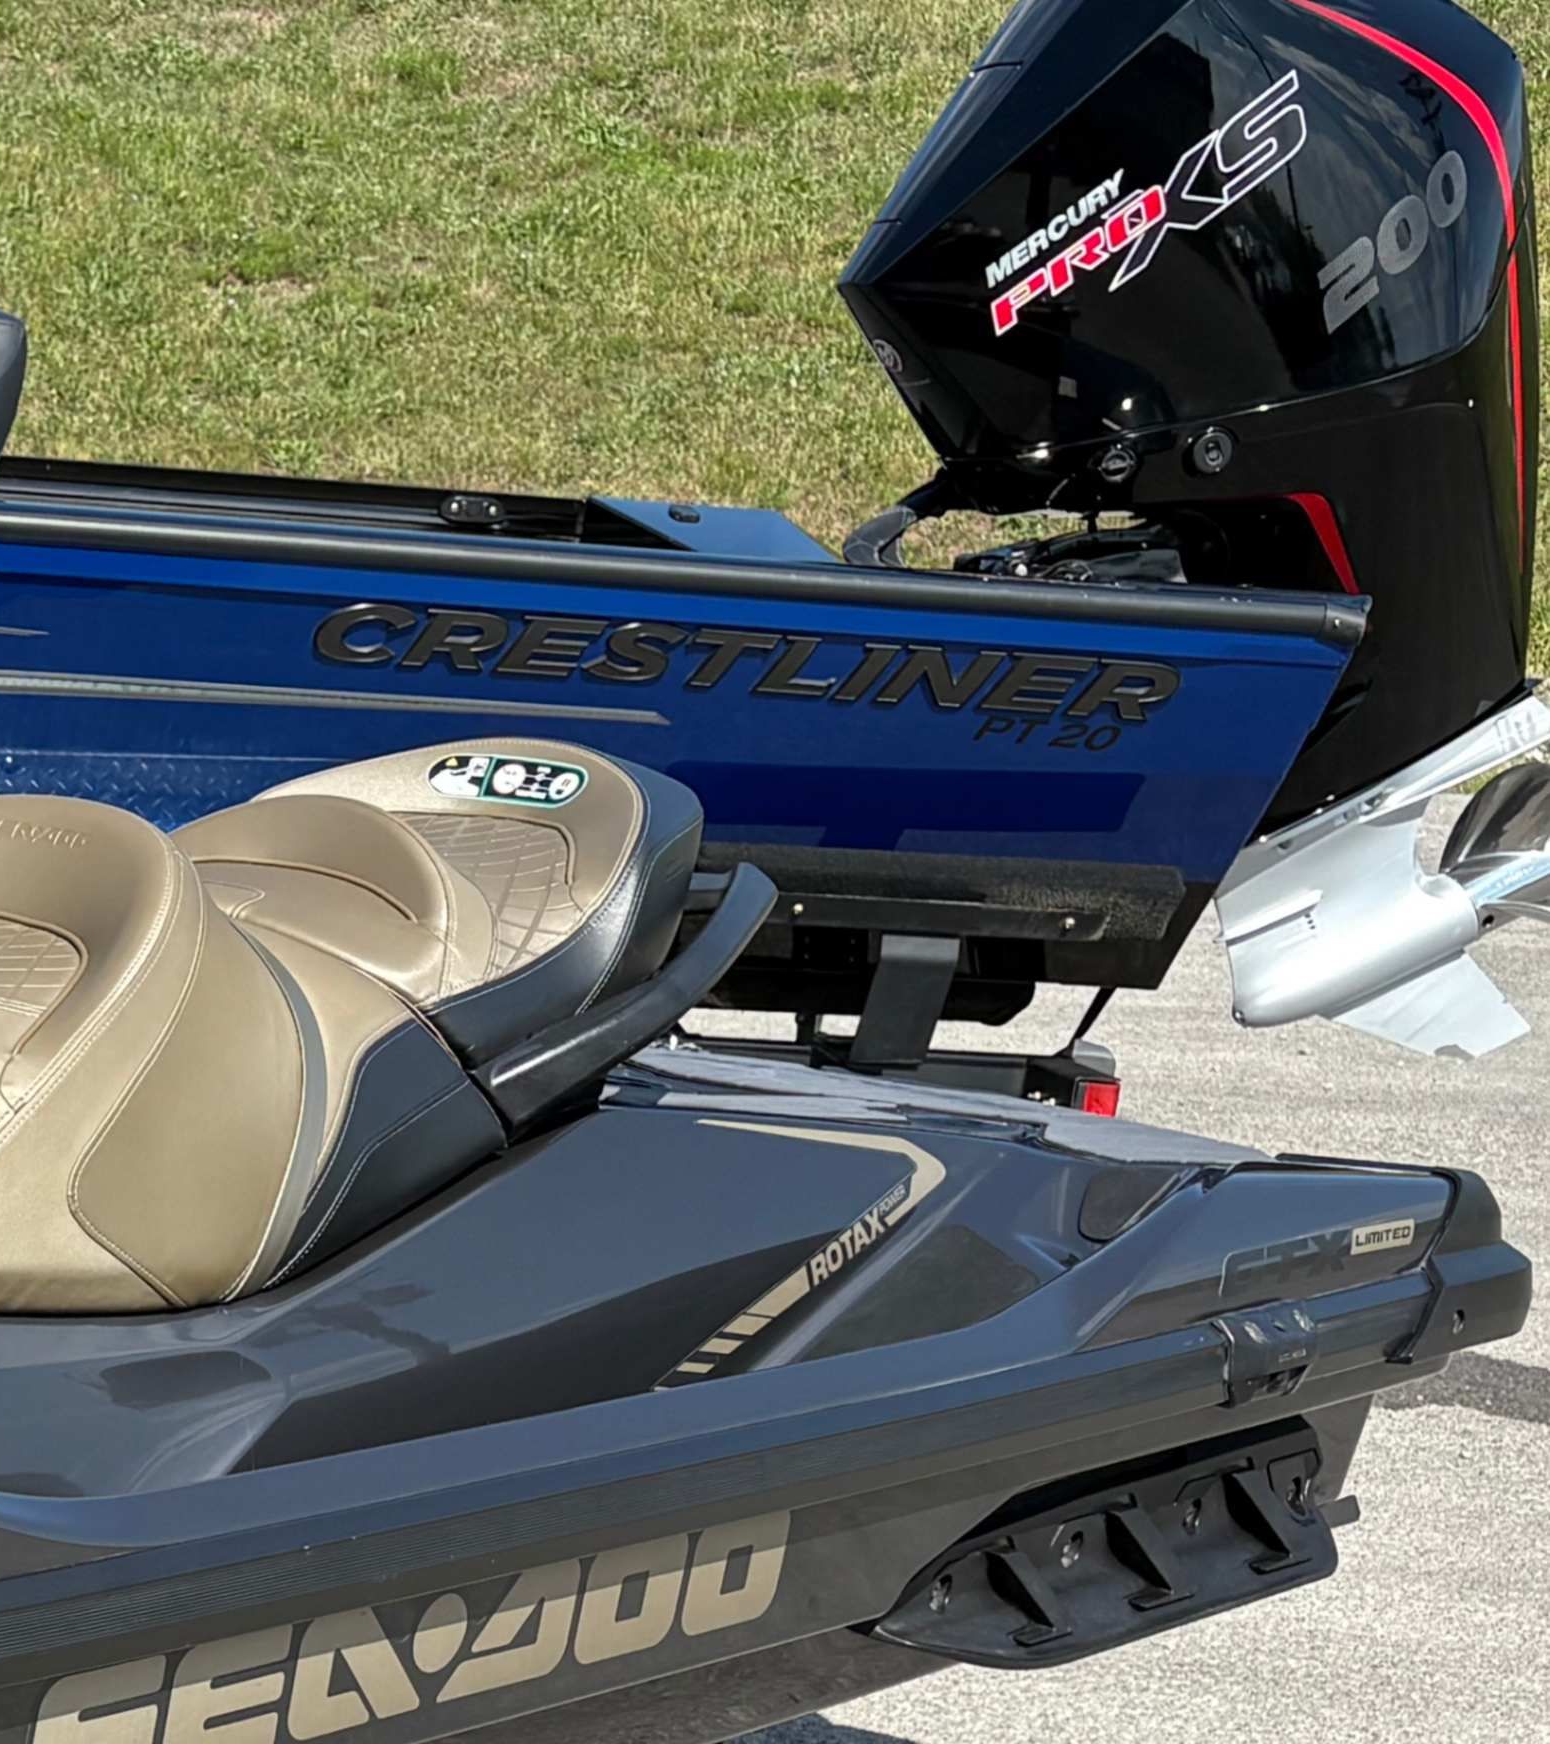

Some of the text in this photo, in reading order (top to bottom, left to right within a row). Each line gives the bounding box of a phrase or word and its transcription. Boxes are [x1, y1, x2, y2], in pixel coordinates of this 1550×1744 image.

[985, 168, 1124, 288] MERCURY
[1317, 150, 1467, 335] 200
[311, 602, 1182, 723] CRESTLINER
[972, 715, 1122, 751] PT 20
[810, 1207, 885, 1286] ROTAX
[1354, 1225, 1412, 1248] LIMITED
